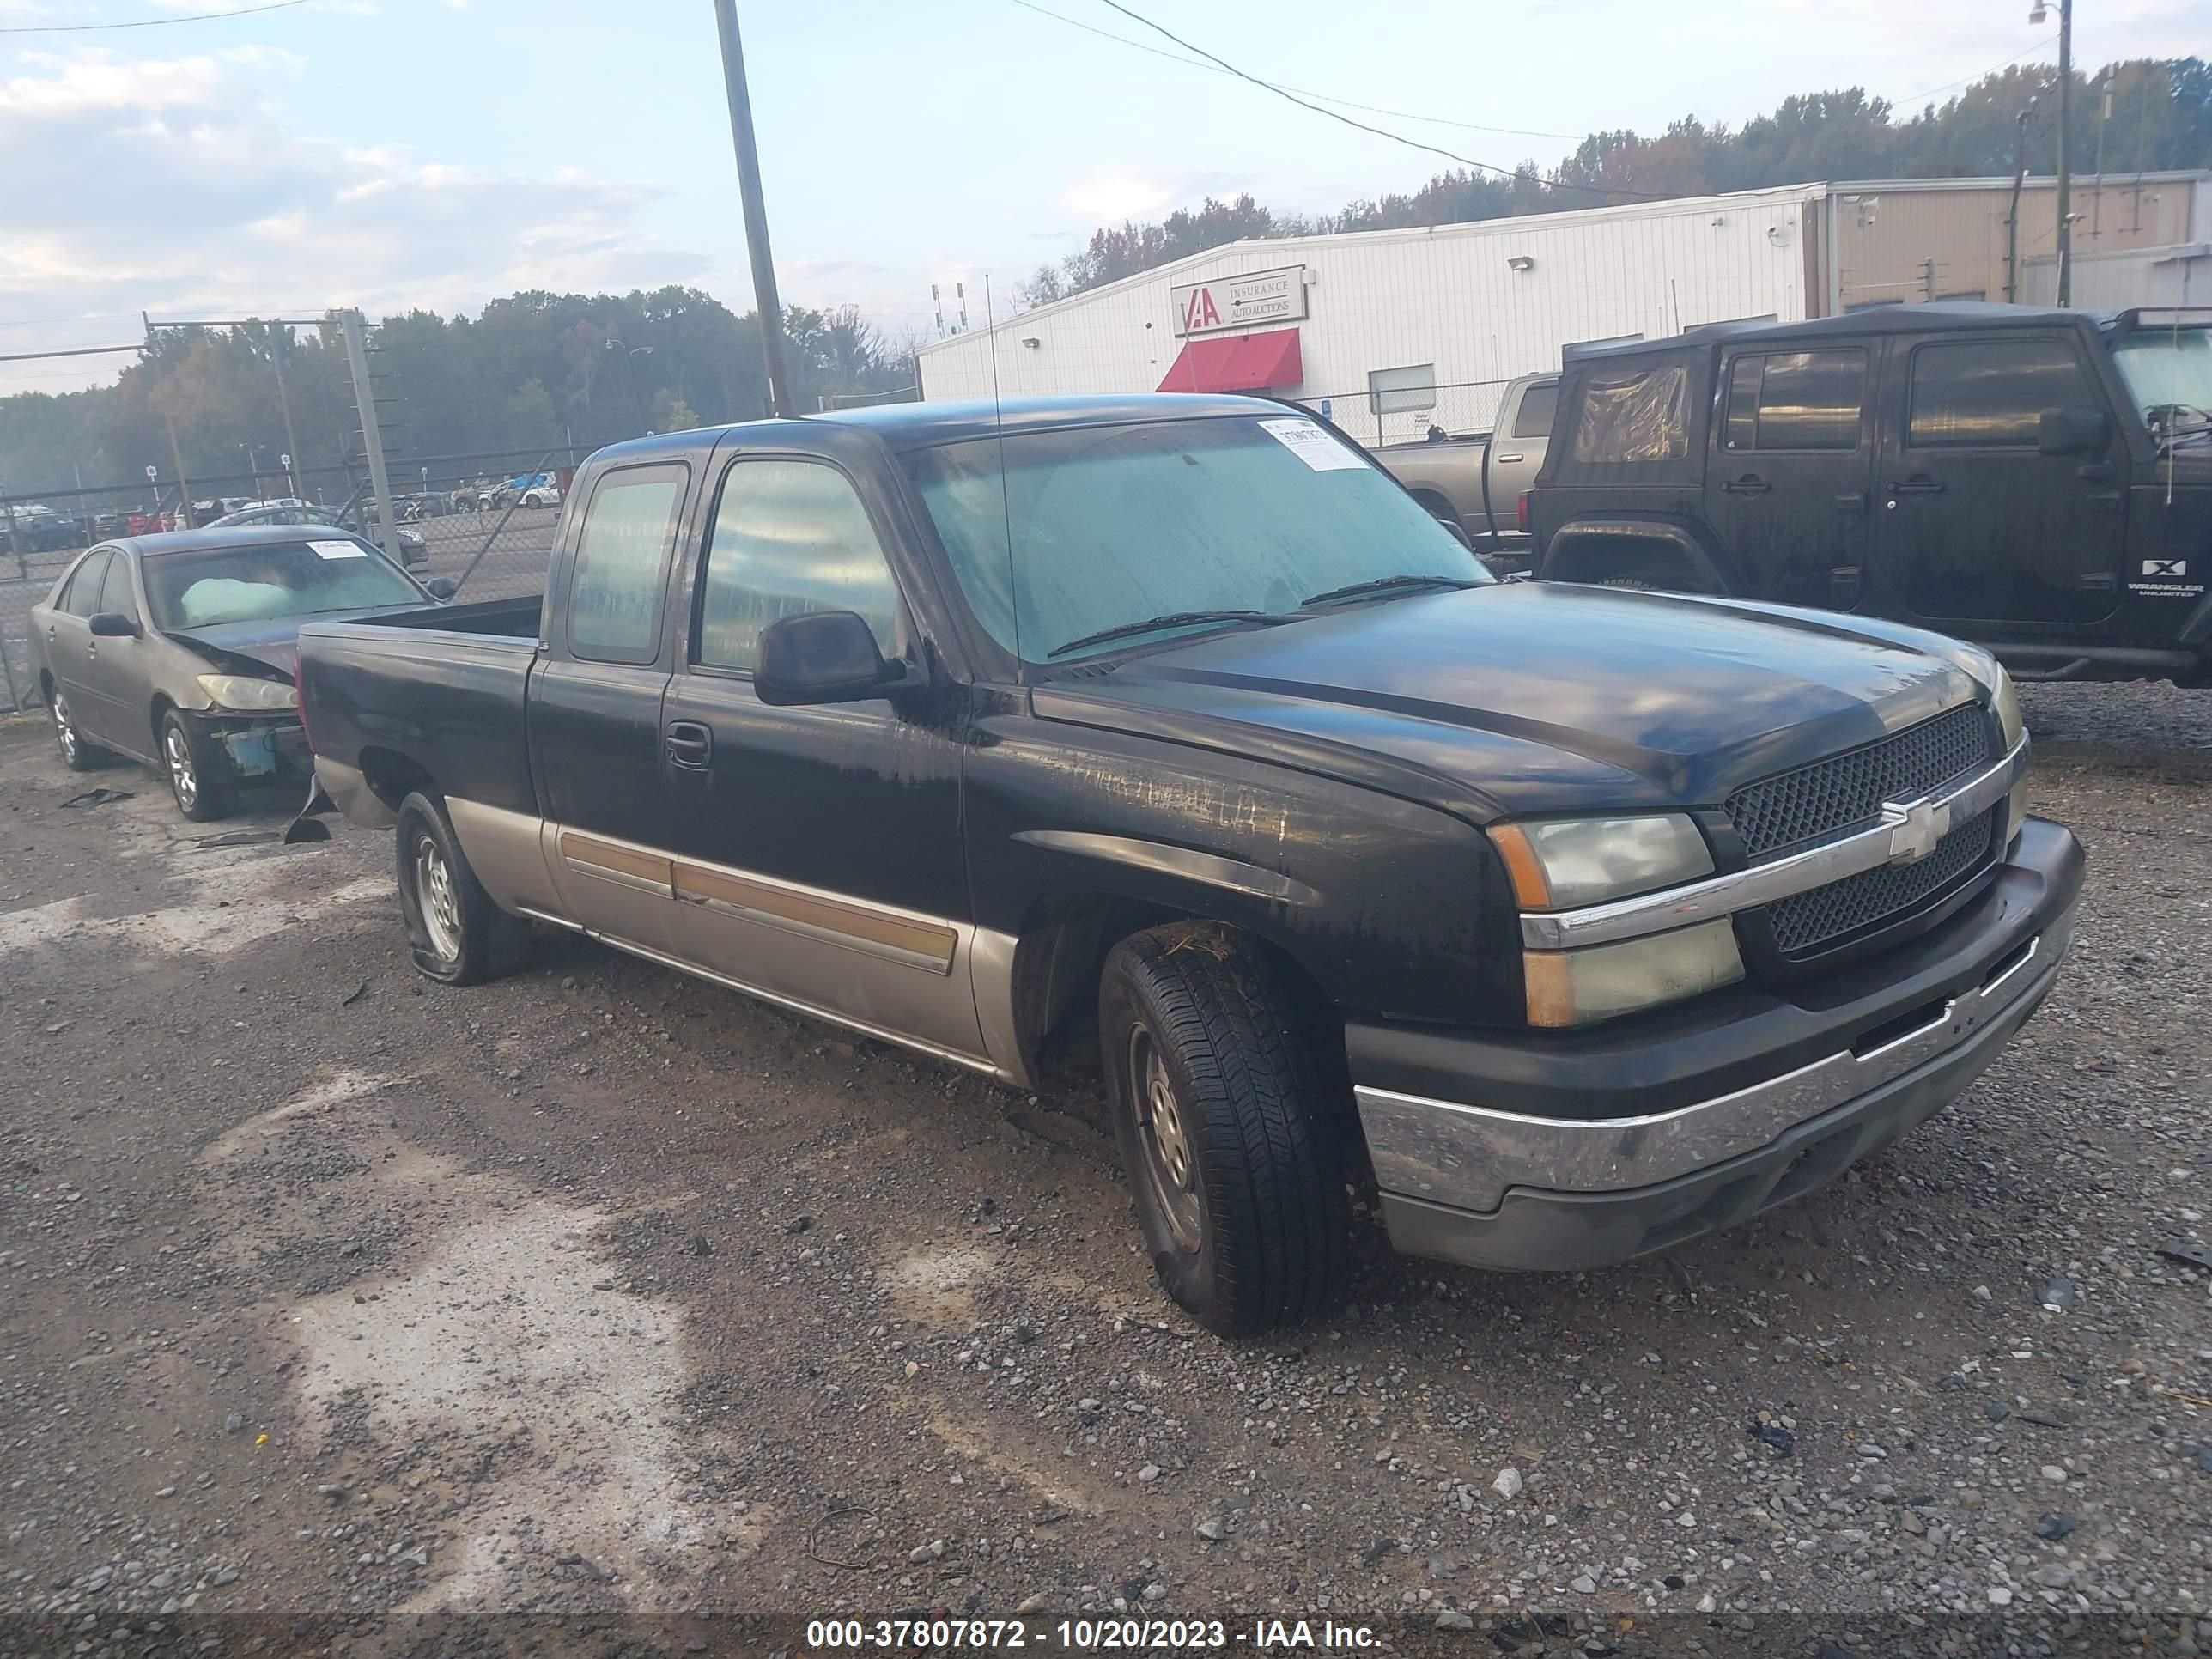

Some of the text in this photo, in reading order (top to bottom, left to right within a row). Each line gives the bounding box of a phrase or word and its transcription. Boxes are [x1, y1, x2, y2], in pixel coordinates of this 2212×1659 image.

[1230, 280, 1288, 299] INSURANCE
[1231, 301, 1289, 319] AUTO AUCTIONS
[2128, 583, 2205, 592] WRANGLER
